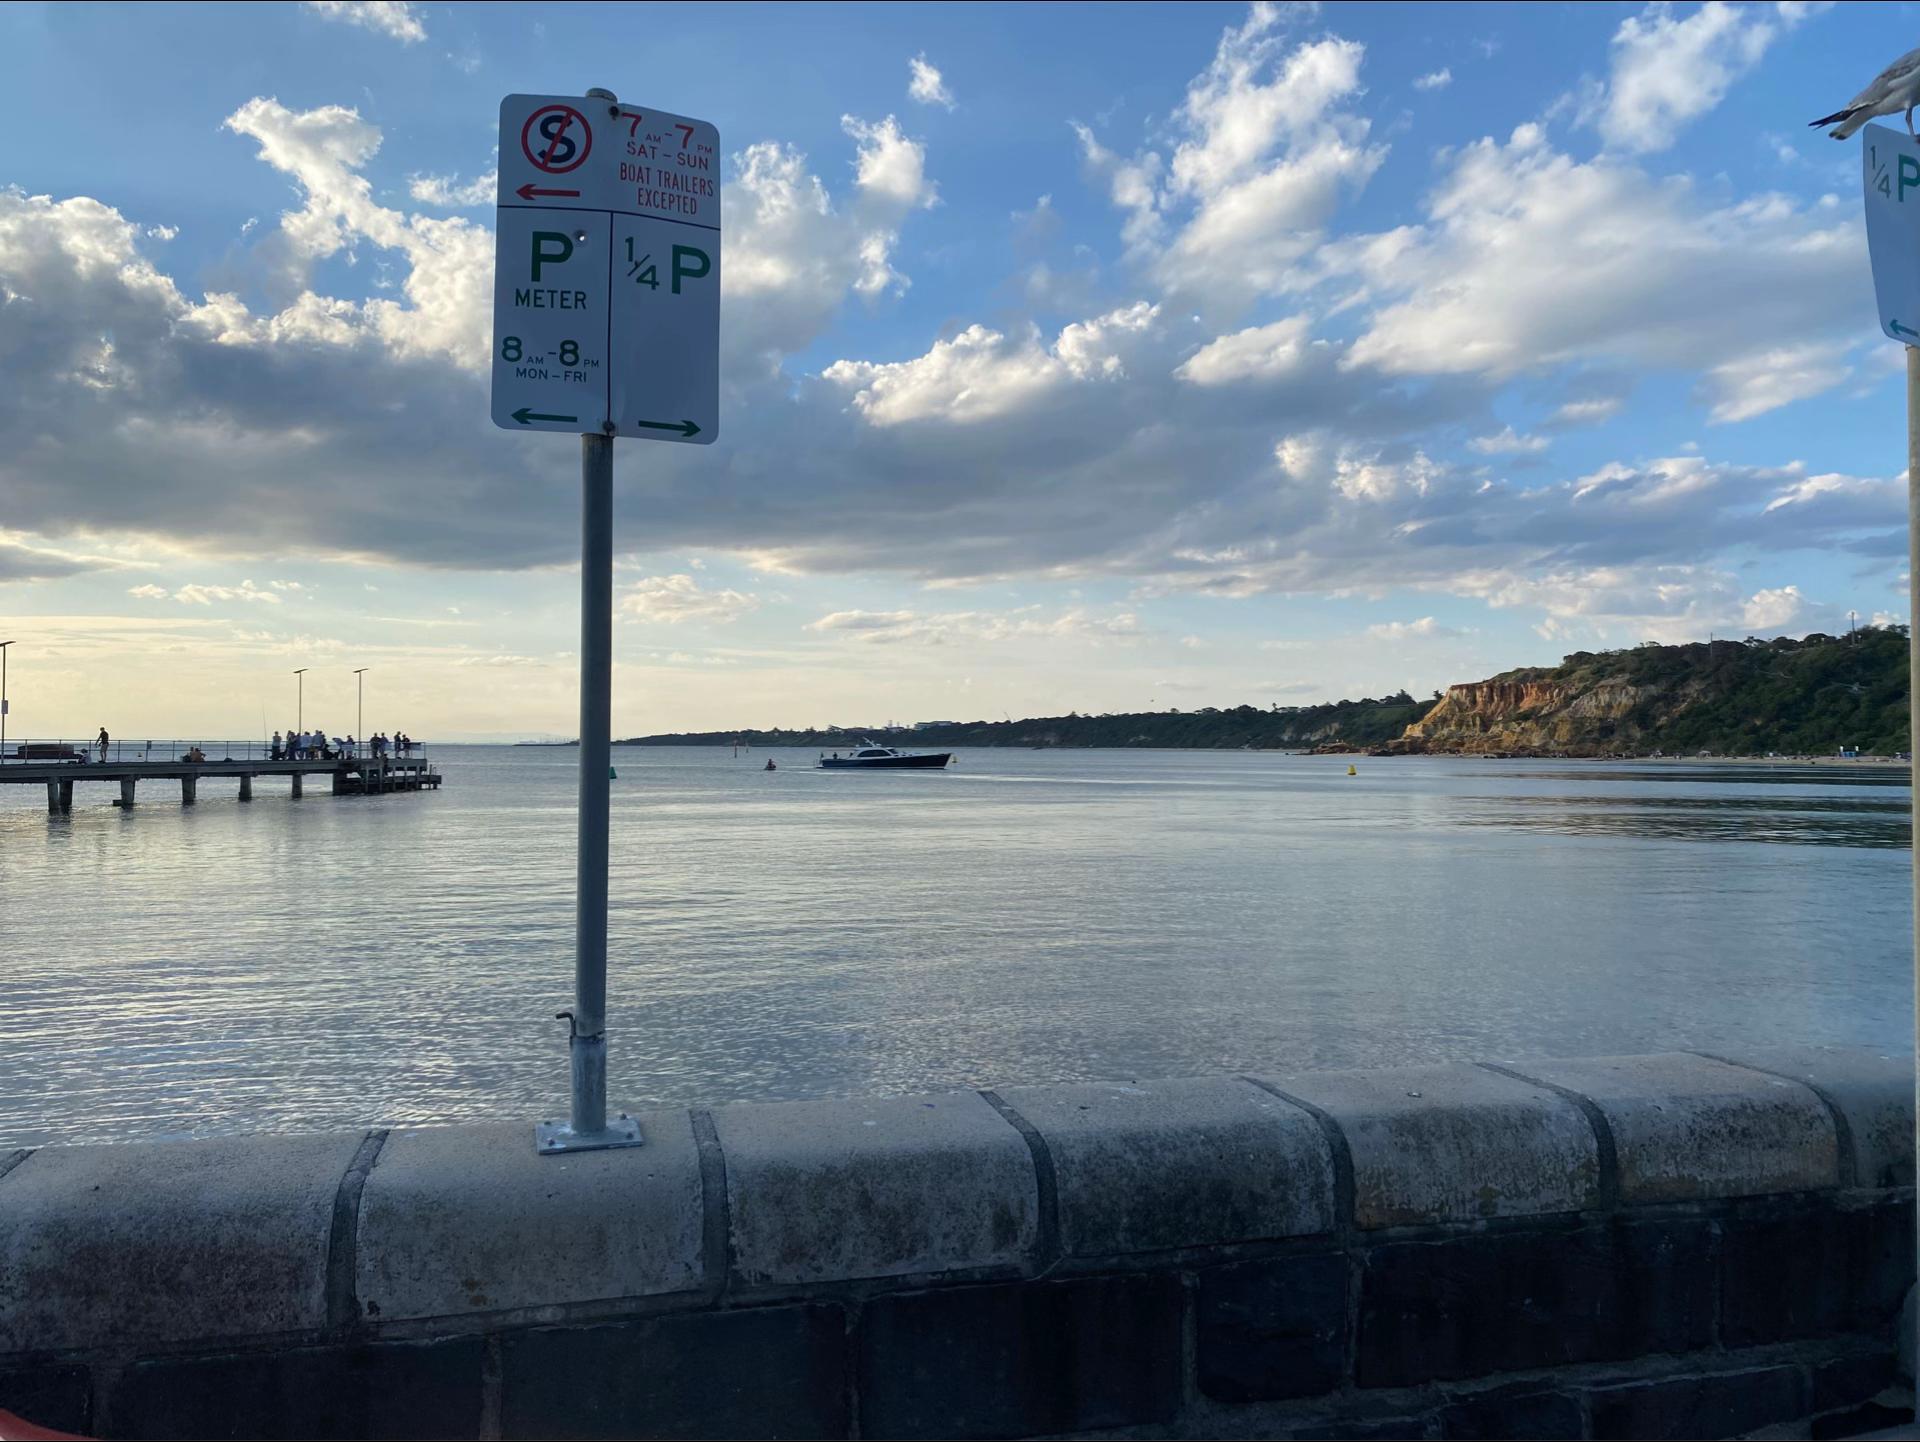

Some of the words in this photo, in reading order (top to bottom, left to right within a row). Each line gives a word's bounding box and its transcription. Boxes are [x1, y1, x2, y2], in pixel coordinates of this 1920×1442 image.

[620, 162, 651, 185] BOAT
[657, 169, 714, 197] TRAILERS
[1897, 153, 1920, 203] P
[637, 187, 697, 215] EXCEPTED
[531, 231, 574, 282] P
[671, 244, 711, 295] P
[515, 288, 587, 310] METER
